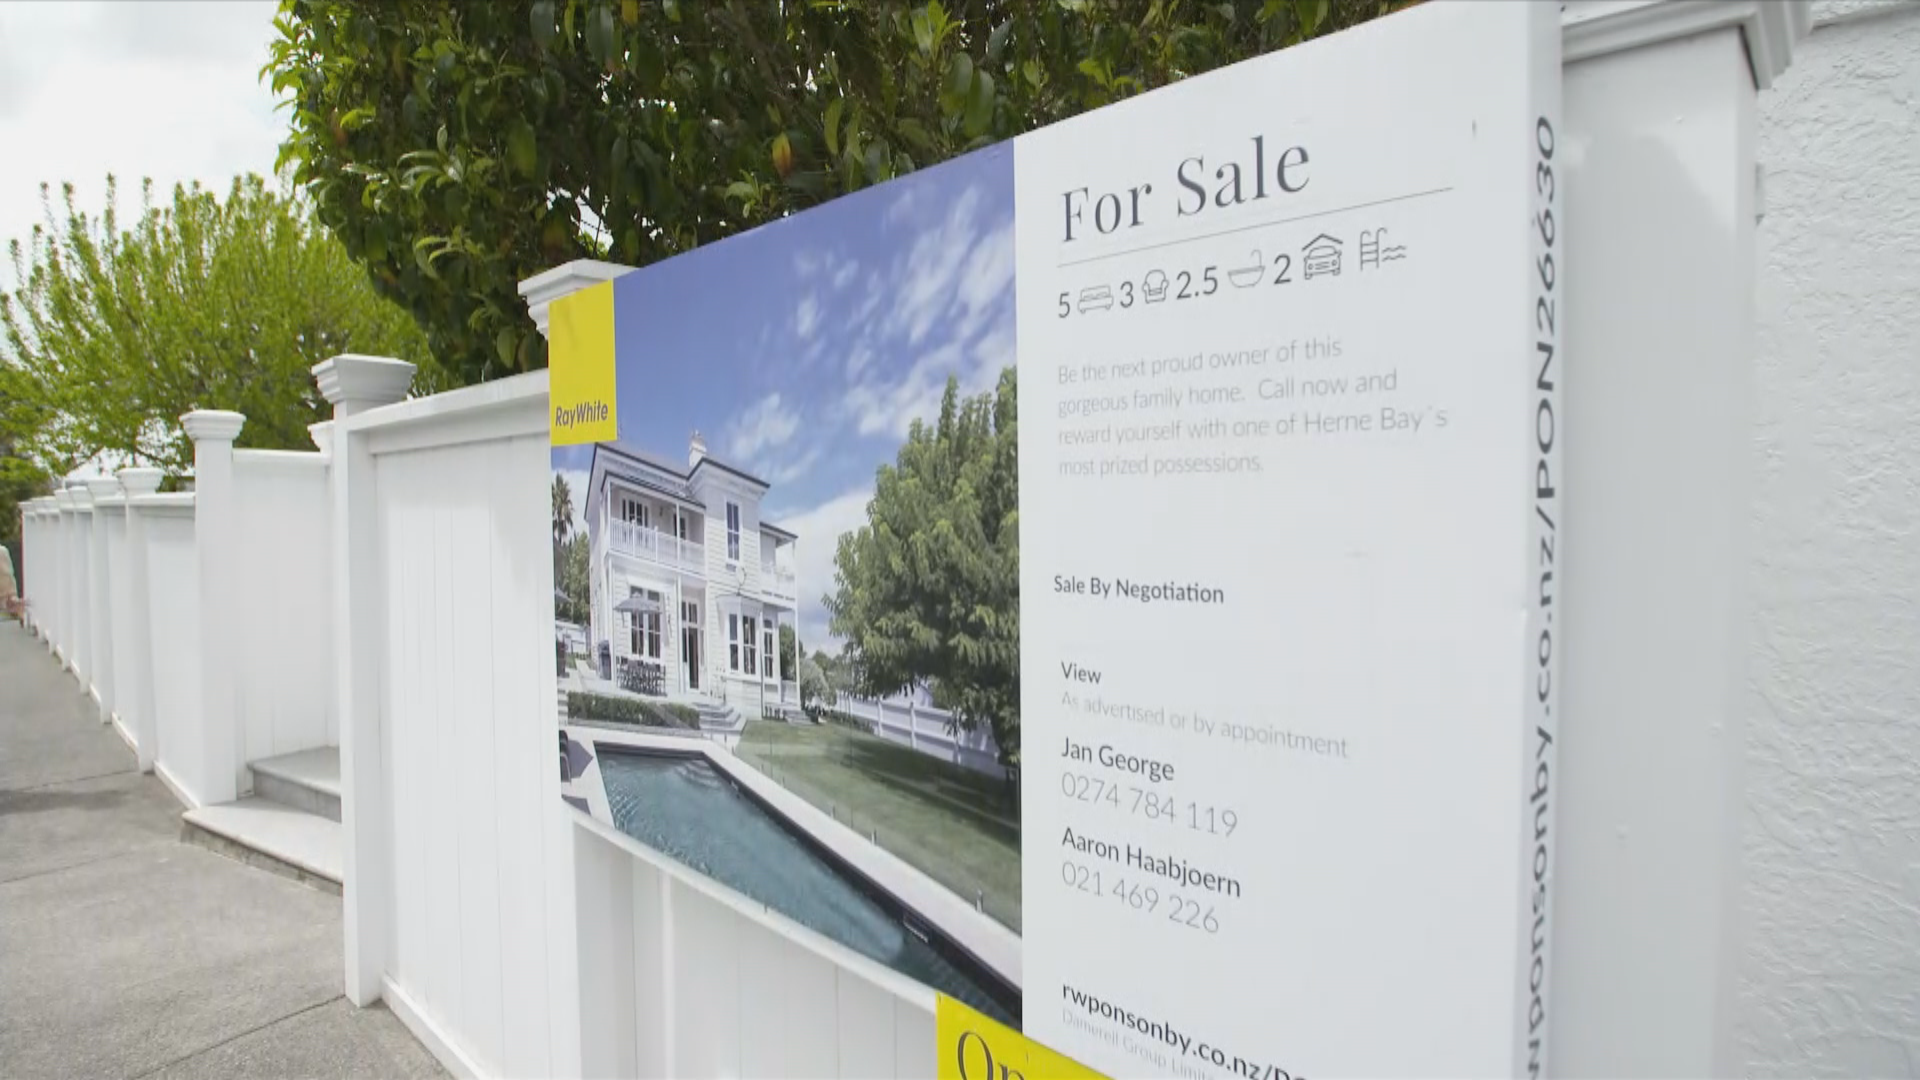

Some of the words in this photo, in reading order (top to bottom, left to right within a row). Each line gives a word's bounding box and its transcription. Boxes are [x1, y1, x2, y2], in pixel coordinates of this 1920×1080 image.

[1061, 183, 1152, 243] For
[1176, 134, 1310, 218] Sale
[1058, 291, 1071, 318] 5
[1119, 281, 1135, 308] 3
[1175, 265, 1219, 301] 2.5
[1273, 253, 1293, 285] 2
[1058, 364, 1078, 385] Be
[1082, 364, 1107, 382] the
[1111, 357, 1147, 379] next
[1151, 352, 1203, 378] proud
[1208, 347, 1269, 370] owner
[1276, 339, 1298, 363] of
[1305, 335, 1343, 361] this
[555, 399, 609, 430] RayWhite
[1058, 395, 1129, 419] gorgeous
[1133, 385, 1183, 410] family
[1188, 385, 1246, 405] home.
[1257, 375, 1295, 400] Call
[1302, 377, 1349, 397] now
[1355, 366, 1398, 394] and
[1058, 424, 1111, 446] reward
[1115, 418, 1183, 446] yourself
[1187, 416, 1228, 439] with
[1232, 419, 1271, 438] one
[1275, 411, 1298, 436] of
[1304, 410, 1374, 434] Herne
[1059, 457, 1095, 476] most
[1100, 453, 1149, 478] prized
[1153, 452, 1264, 478] possessions.
[1054, 574, 1086, 594] Sale
[1090, 577, 1112, 599] By
[1116, 578, 1225, 604] Negotiation
[1061, 661, 1102, 685] View
[1061, 690, 1079, 709] As
[1084, 694, 1165, 728] advertised
[1169, 711, 1188, 731] or
[1193, 712, 1216, 737] by
[1221, 719, 1350, 760] appointment
[1061, 737, 1093, 764] Jan
[1099, 744, 1175, 784] George
[1061, 771, 1121, 809] 0274
[1128, 786, 1178, 825] 784
[1187, 801, 1239, 838] 119
[1061, 826, 1120, 863] Aaron
[1126, 844, 1242, 898] Haabjoern
[1061, 861, 1105, 898] 021
[1112, 876, 1160, 914] 469
[1168, 893, 1220, 935] 226
[1062, 982, 1308, 1080] rwponsonby.co.nz/
[1122, 1034, 1168, 1069] Group
